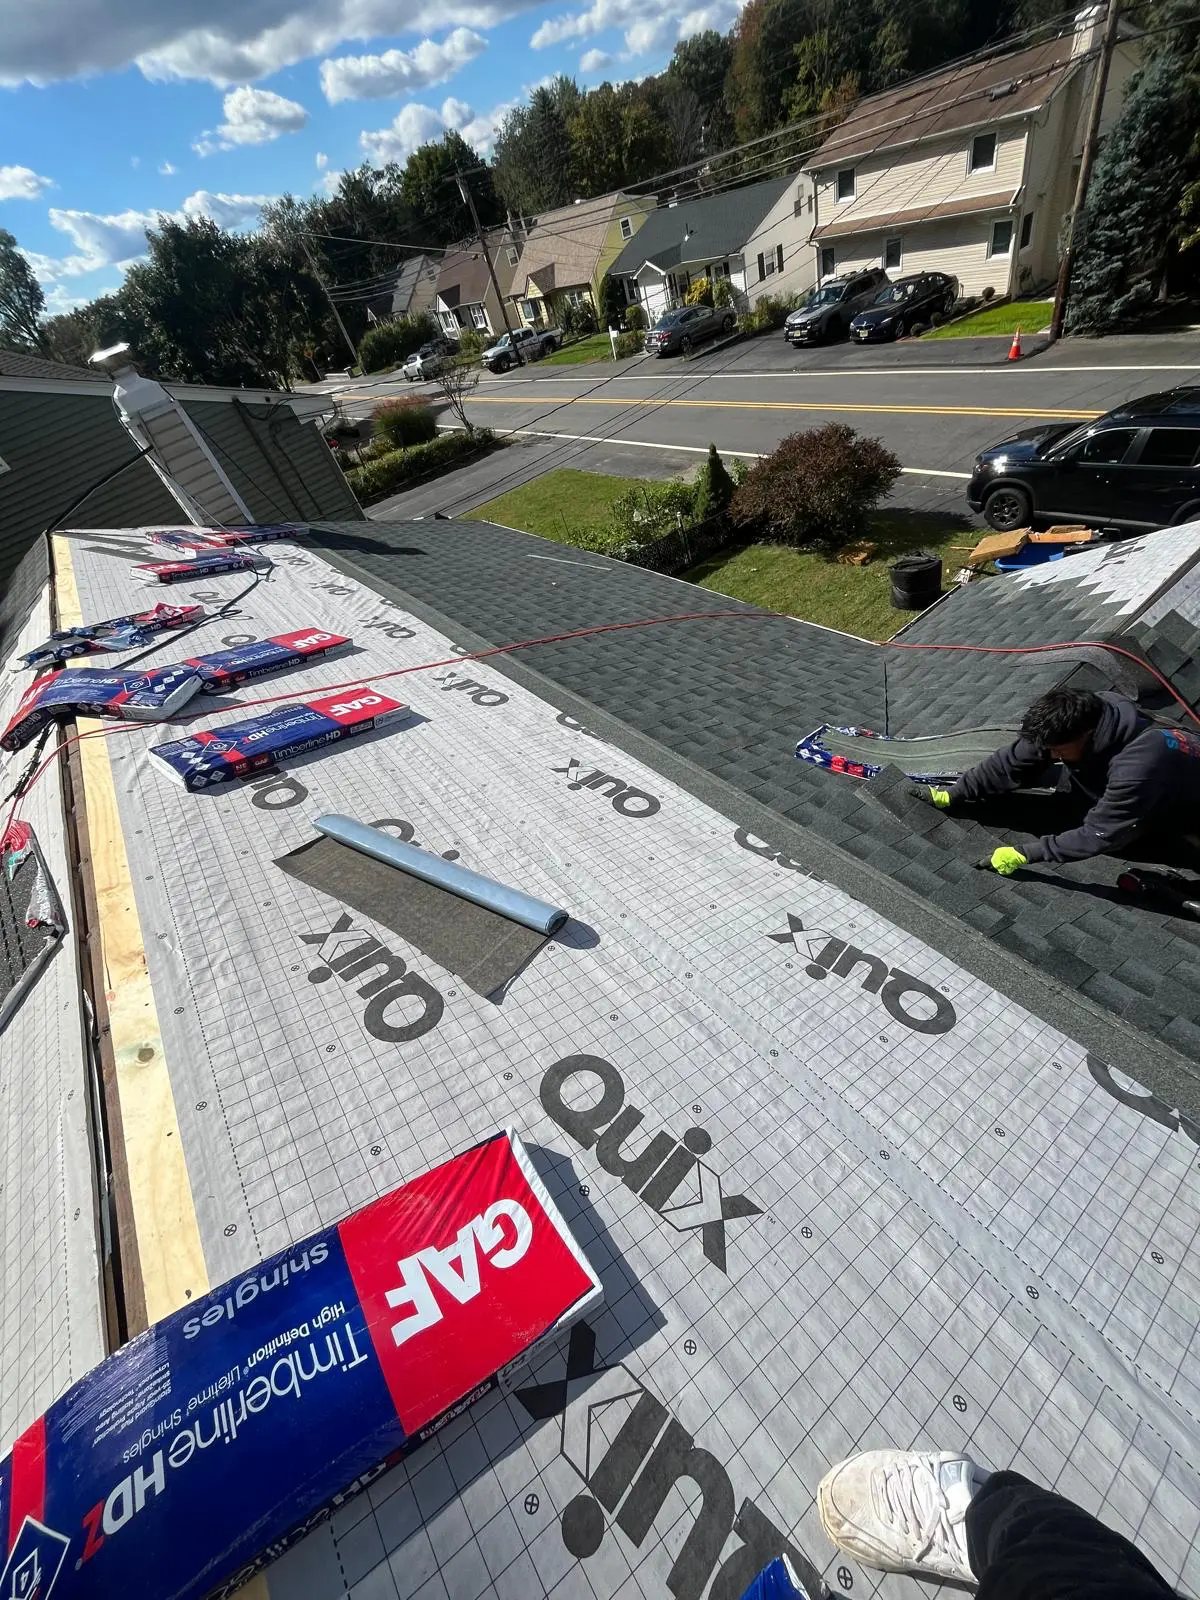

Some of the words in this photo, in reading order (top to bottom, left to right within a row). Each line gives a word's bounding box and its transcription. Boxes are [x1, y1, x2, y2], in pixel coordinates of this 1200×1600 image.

[292, 633, 332, 649] GAF
[328, 695, 383, 716] GAF
[432, 672, 510, 706] Quix
[550, 757, 661, 819] Quix
[297, 912, 445, 1043] Quix
[765, 912, 957, 1035] Quix
[182, 1242, 329, 1340] Shingles
[384, 1198, 533, 1347] GAF
[312, 1300, 346, 1331] High
[123, 1408, 182, 1464] Shingles
